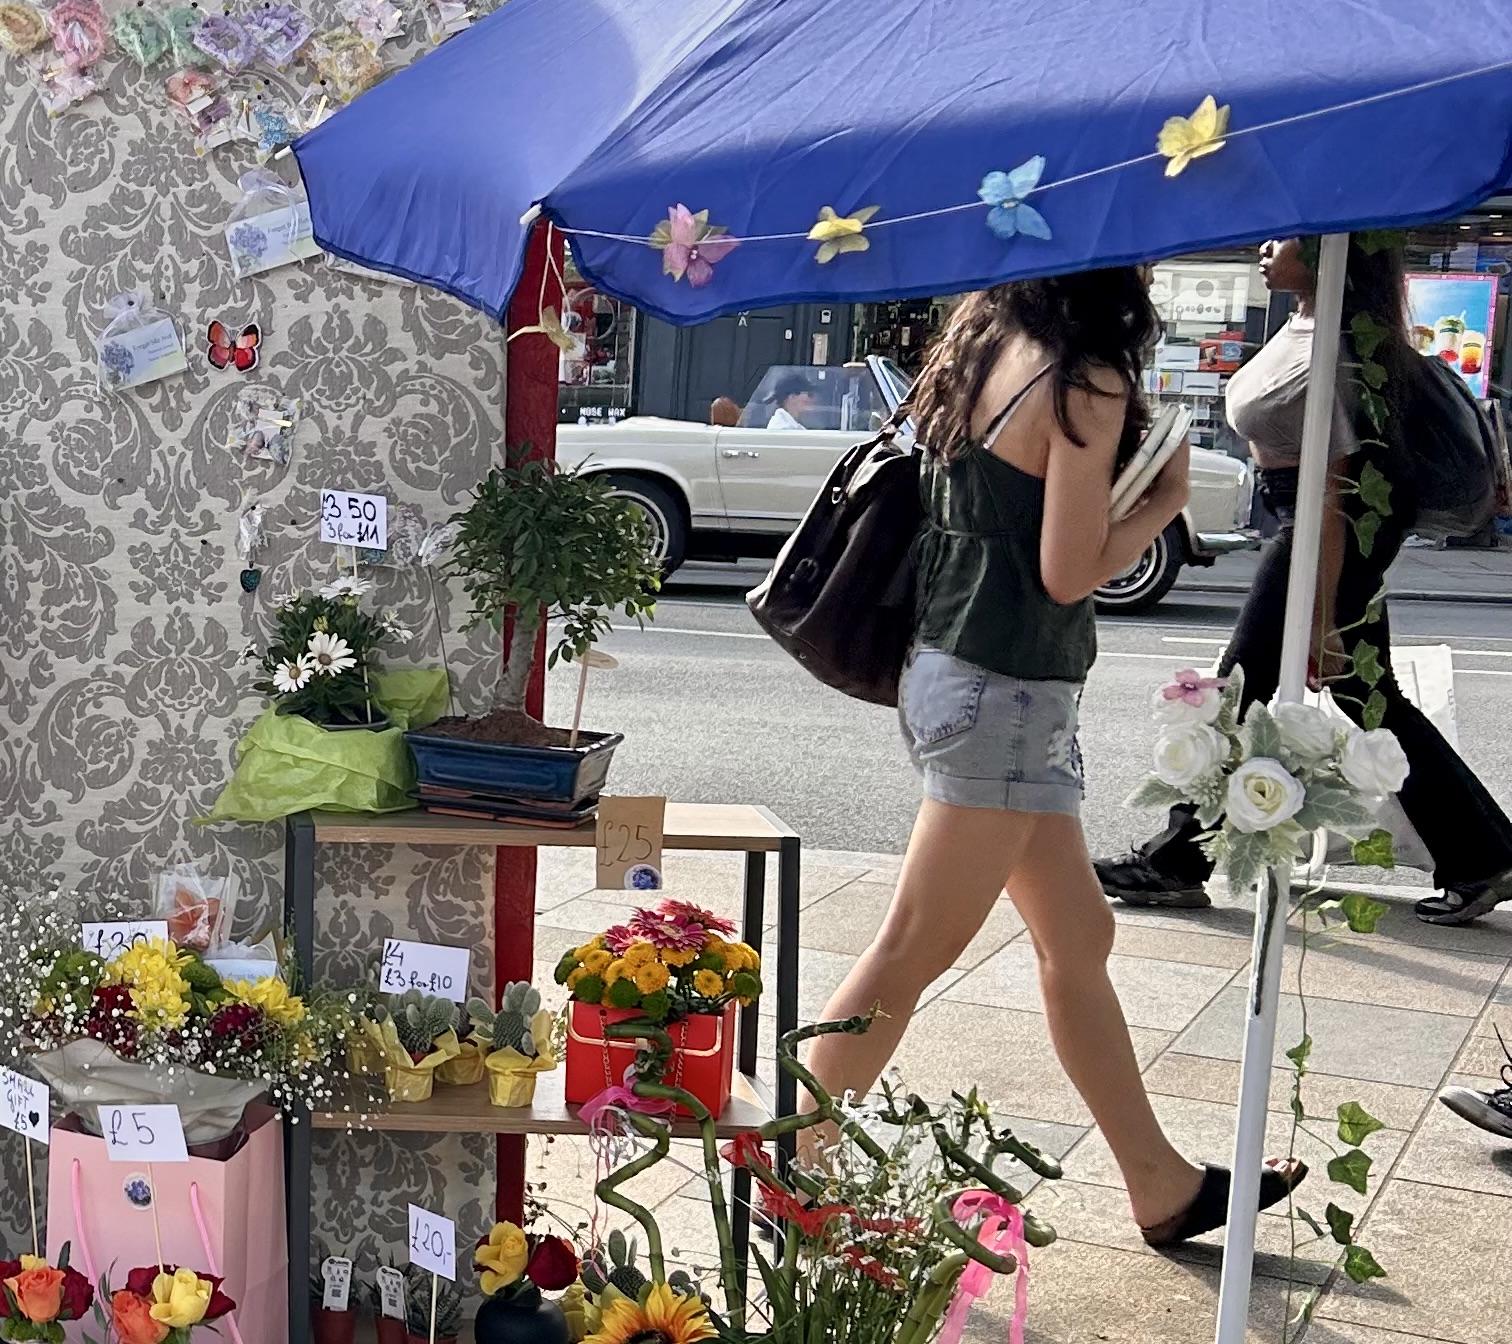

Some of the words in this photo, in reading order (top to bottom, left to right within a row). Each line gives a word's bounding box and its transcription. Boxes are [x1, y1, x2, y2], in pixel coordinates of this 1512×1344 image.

[608, 407, 626, 417] WAX
[599, 820, 653, 868] £25
[381, 941, 404, 966] £4
[385, 968, 406, 987] £3
[429, 972, 453, 993] £10
[14, 1111, 28, 1131] £5
[109, 1109, 155, 1145] £5
